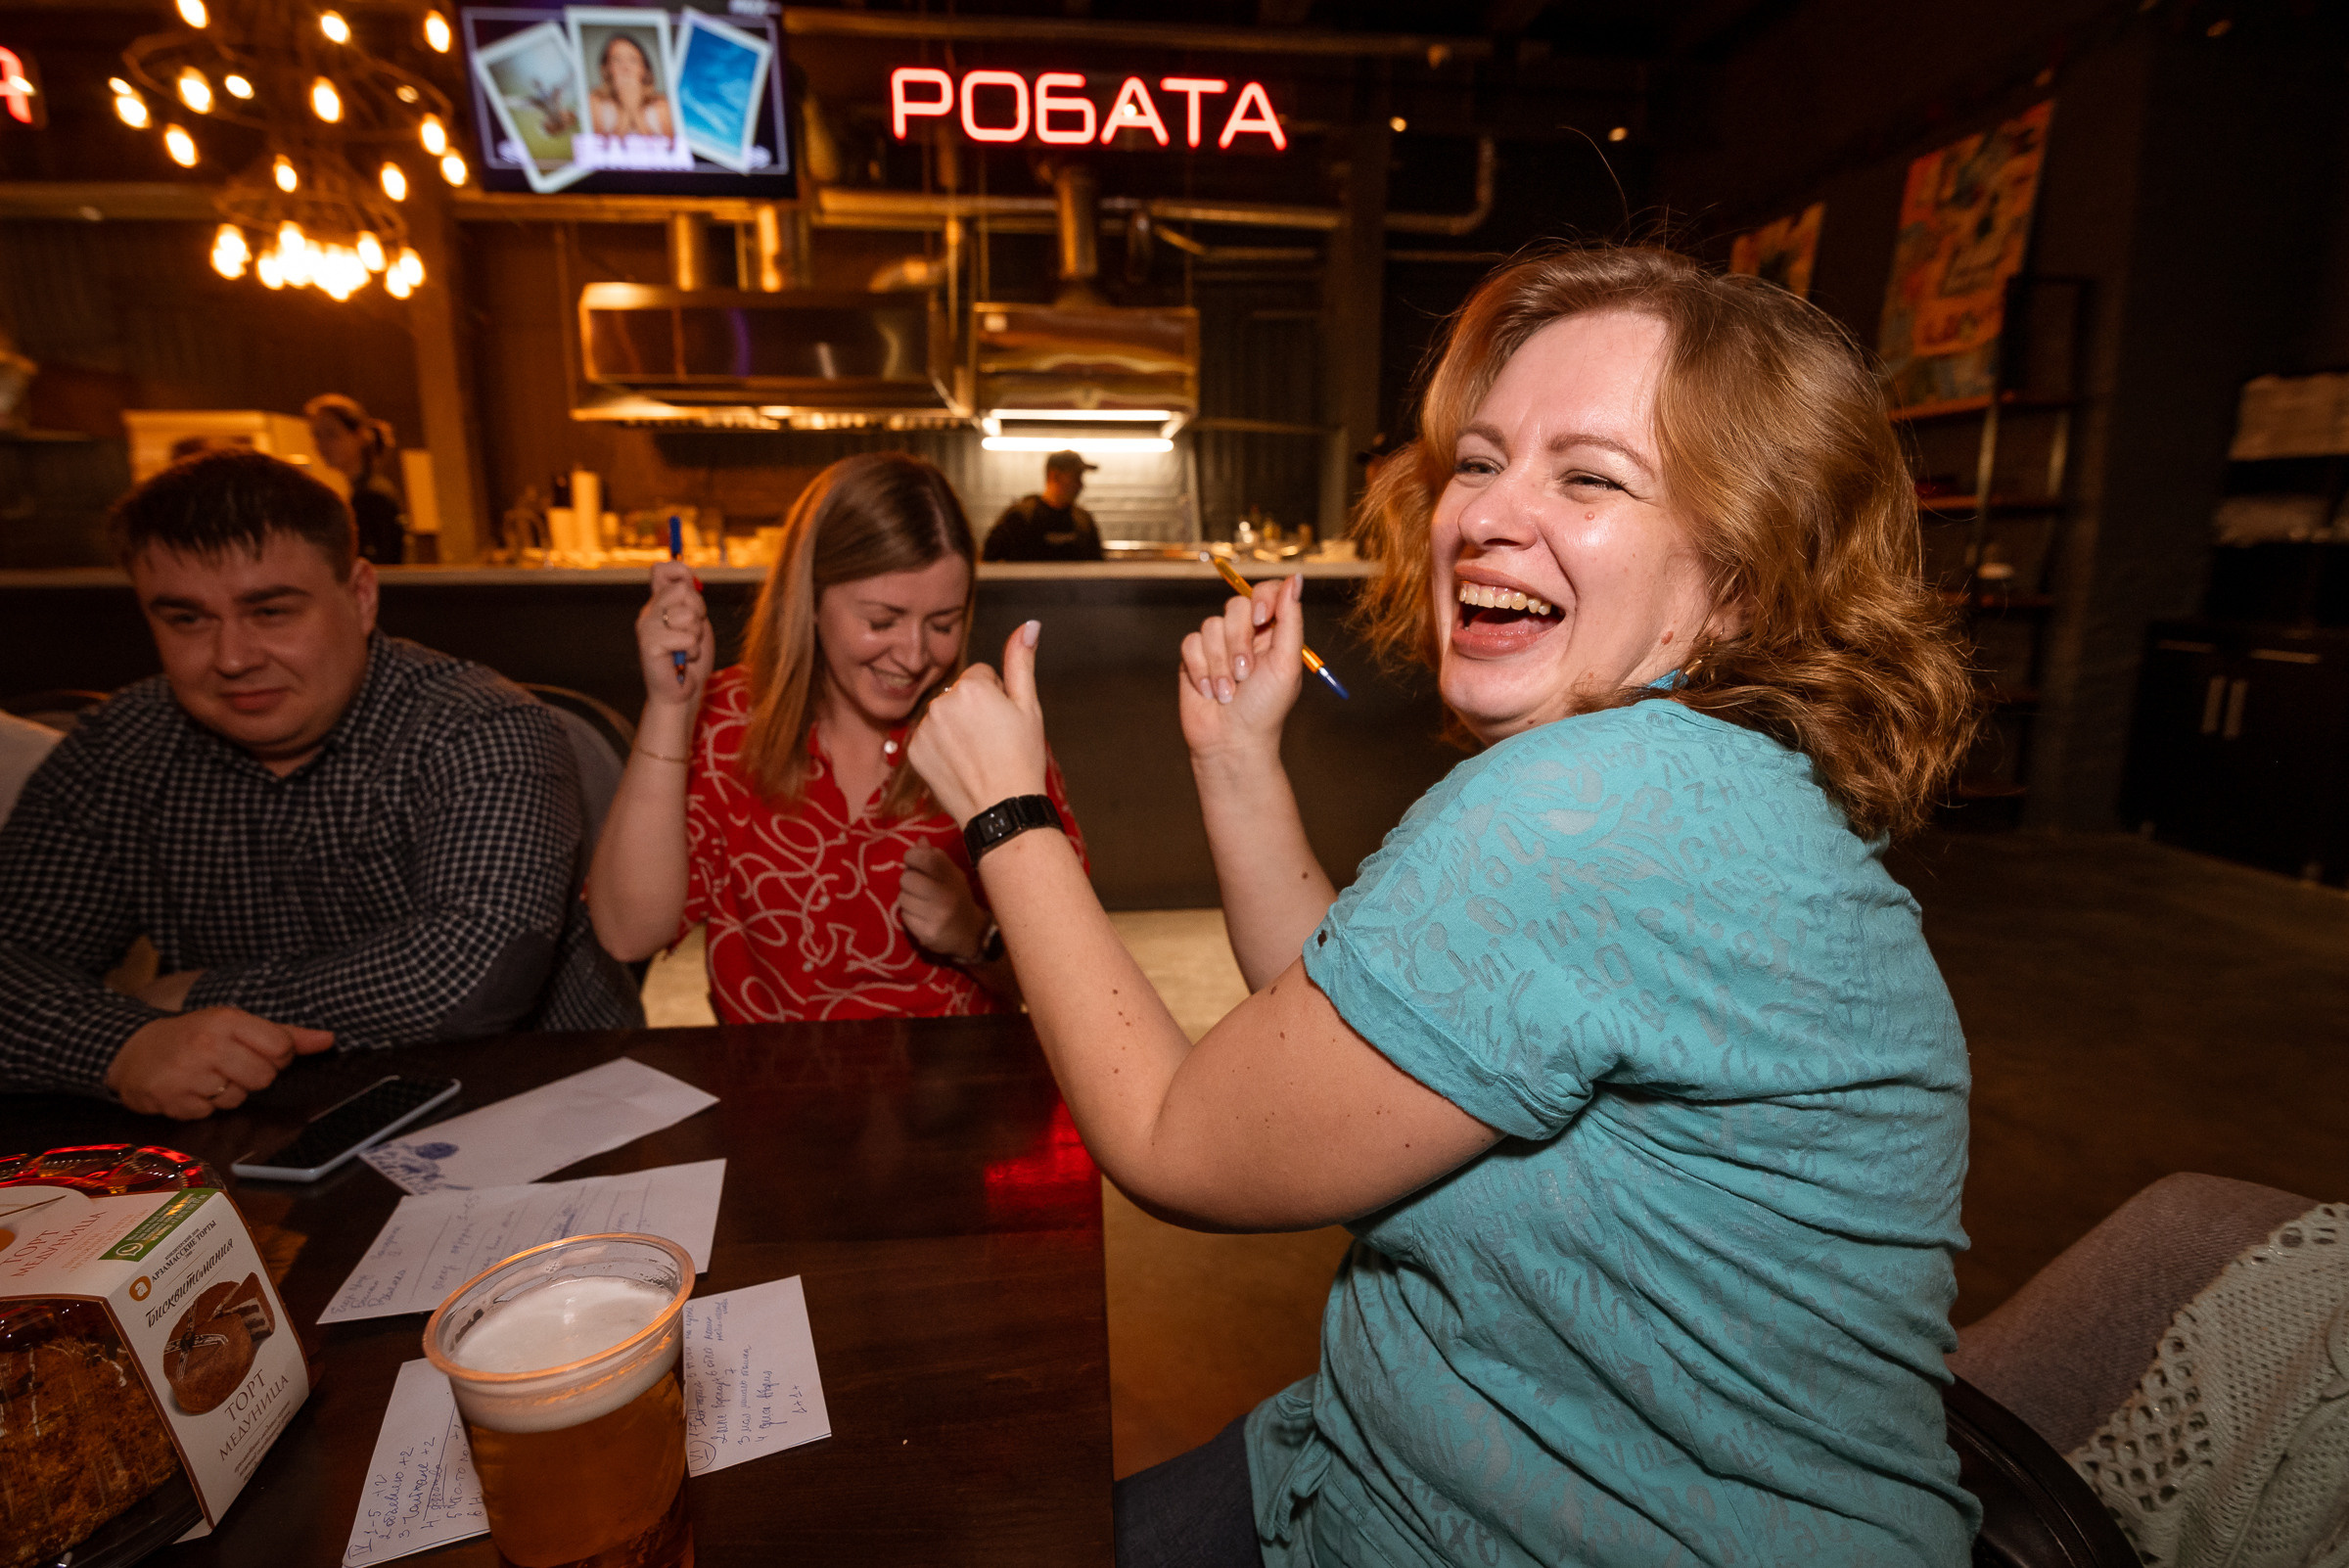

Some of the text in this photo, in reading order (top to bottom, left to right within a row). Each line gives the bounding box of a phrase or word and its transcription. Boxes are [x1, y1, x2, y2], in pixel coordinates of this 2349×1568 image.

[891, 67, 1287, 151] РОБАТА
[0, 1230, 61, 1266] ТОРТ
[10, 1211, 108, 1277] МЕДУНИЦА
[152, 1239, 198, 1283] АРЗАМАССКИЕ
[196, 1220, 217, 1241] ТОРТЫ
[219, 1374, 289, 1461] МЕДУНИЦА
[224, 1368, 265, 1422] ТОРТ
